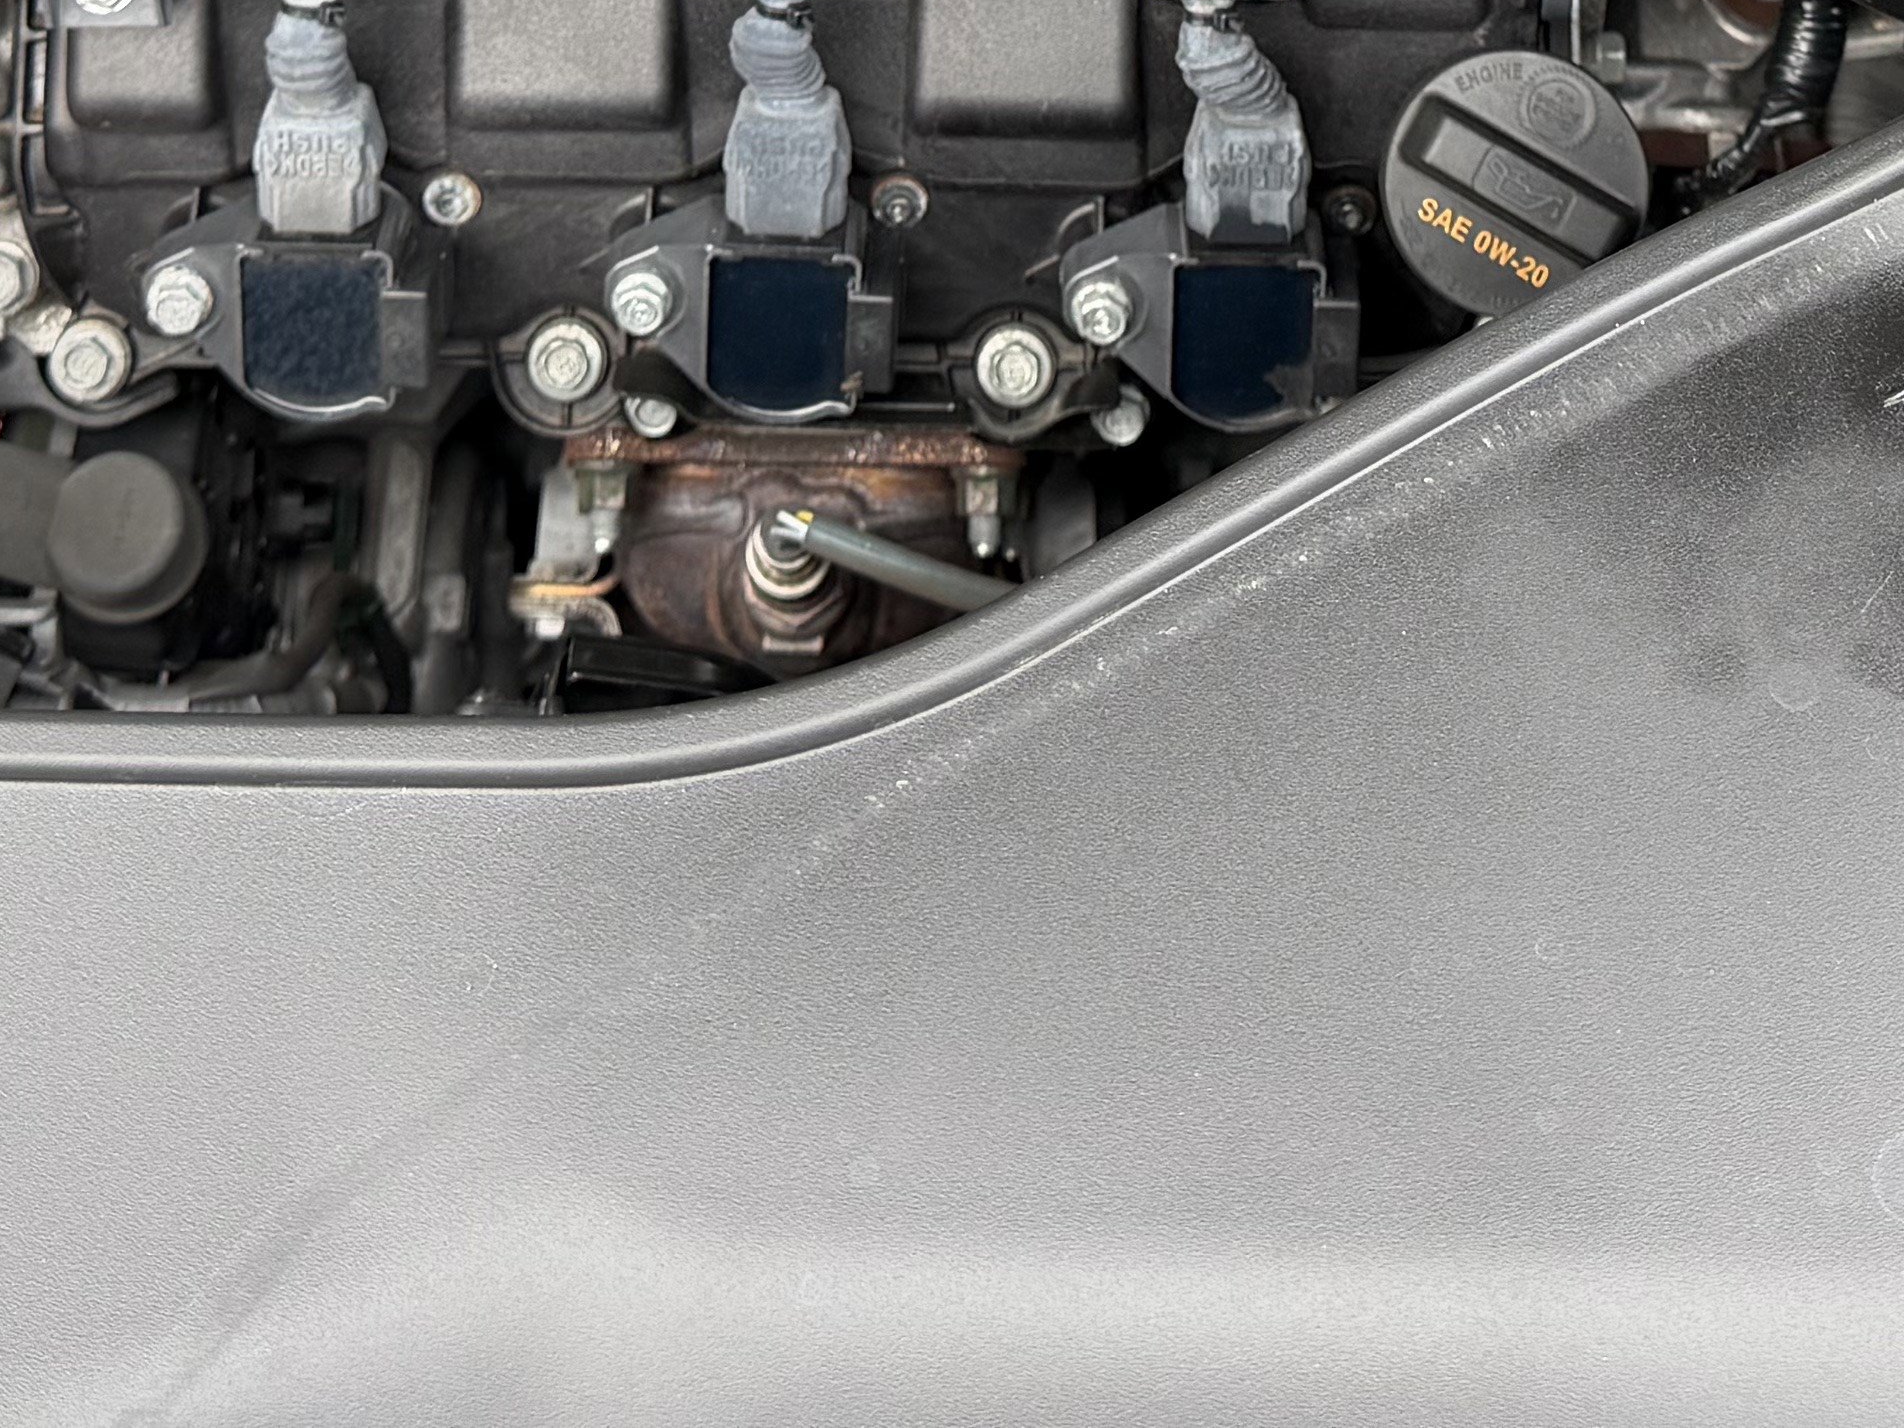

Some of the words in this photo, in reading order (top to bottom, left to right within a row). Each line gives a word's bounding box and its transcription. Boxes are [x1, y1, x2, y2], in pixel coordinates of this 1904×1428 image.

[1454, 62, 1523, 95] ENGINE
[273, 130, 348, 154] PUSH
[1416, 197, 1474, 244] SAE
[1473, 229, 1551, 289] 0W-20
